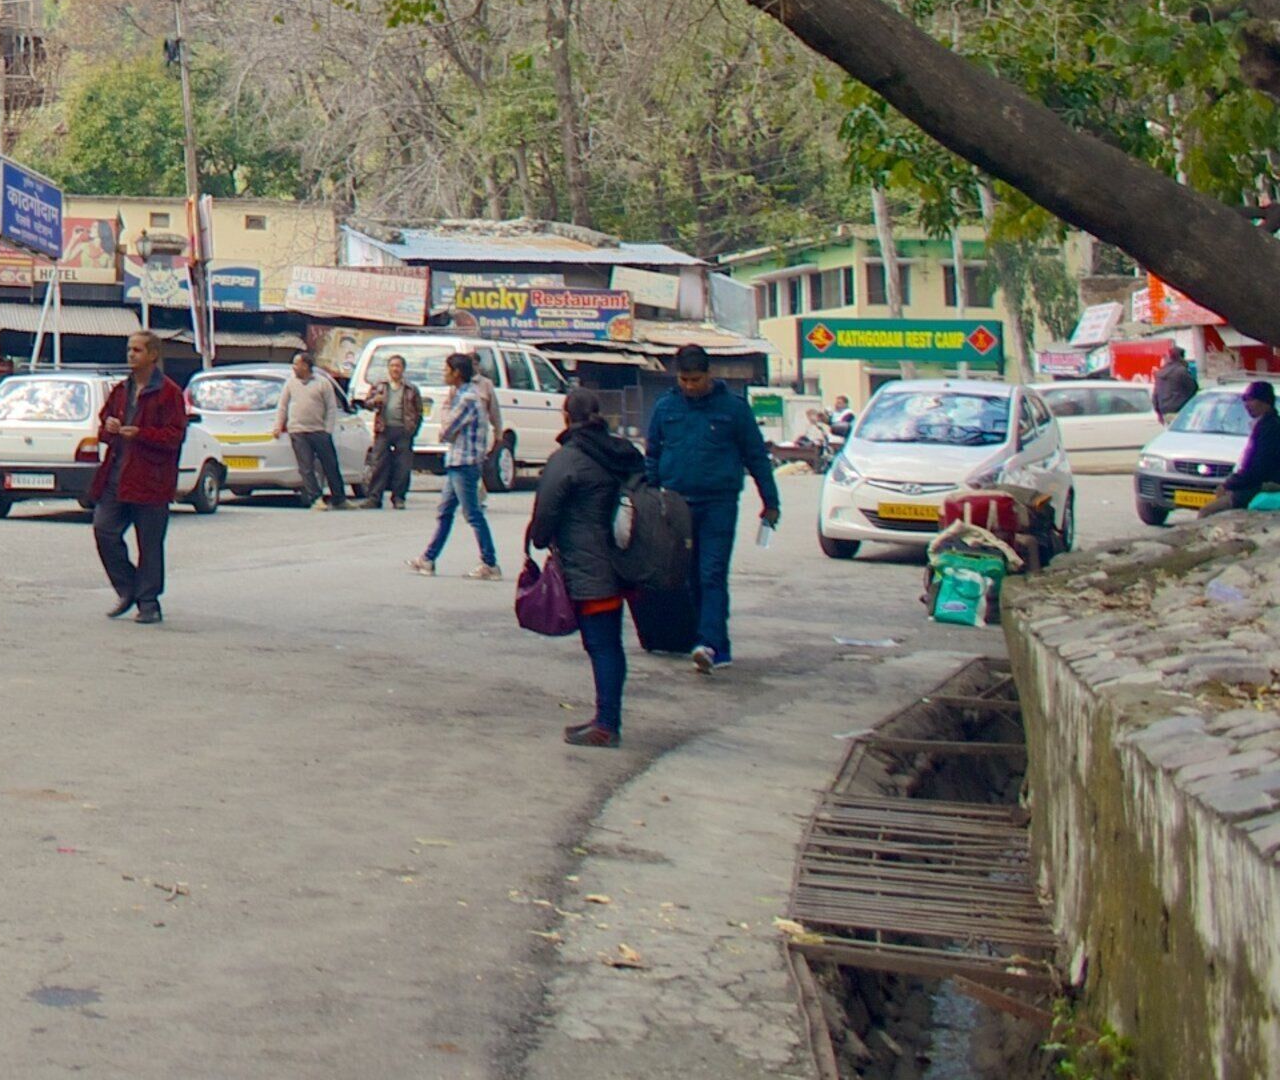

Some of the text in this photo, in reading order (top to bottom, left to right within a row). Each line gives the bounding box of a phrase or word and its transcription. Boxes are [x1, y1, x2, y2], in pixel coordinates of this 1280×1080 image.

[6, 185, 60, 226] काठगोदाम
[211, 274, 256, 287] PEPSI
[455, 286, 630, 313] Lucky Restaurant
[479, 316, 606, 330] Break Fast Lunch Dinner
[837, 330, 966, 349] KATHGODAM REST CAMP
